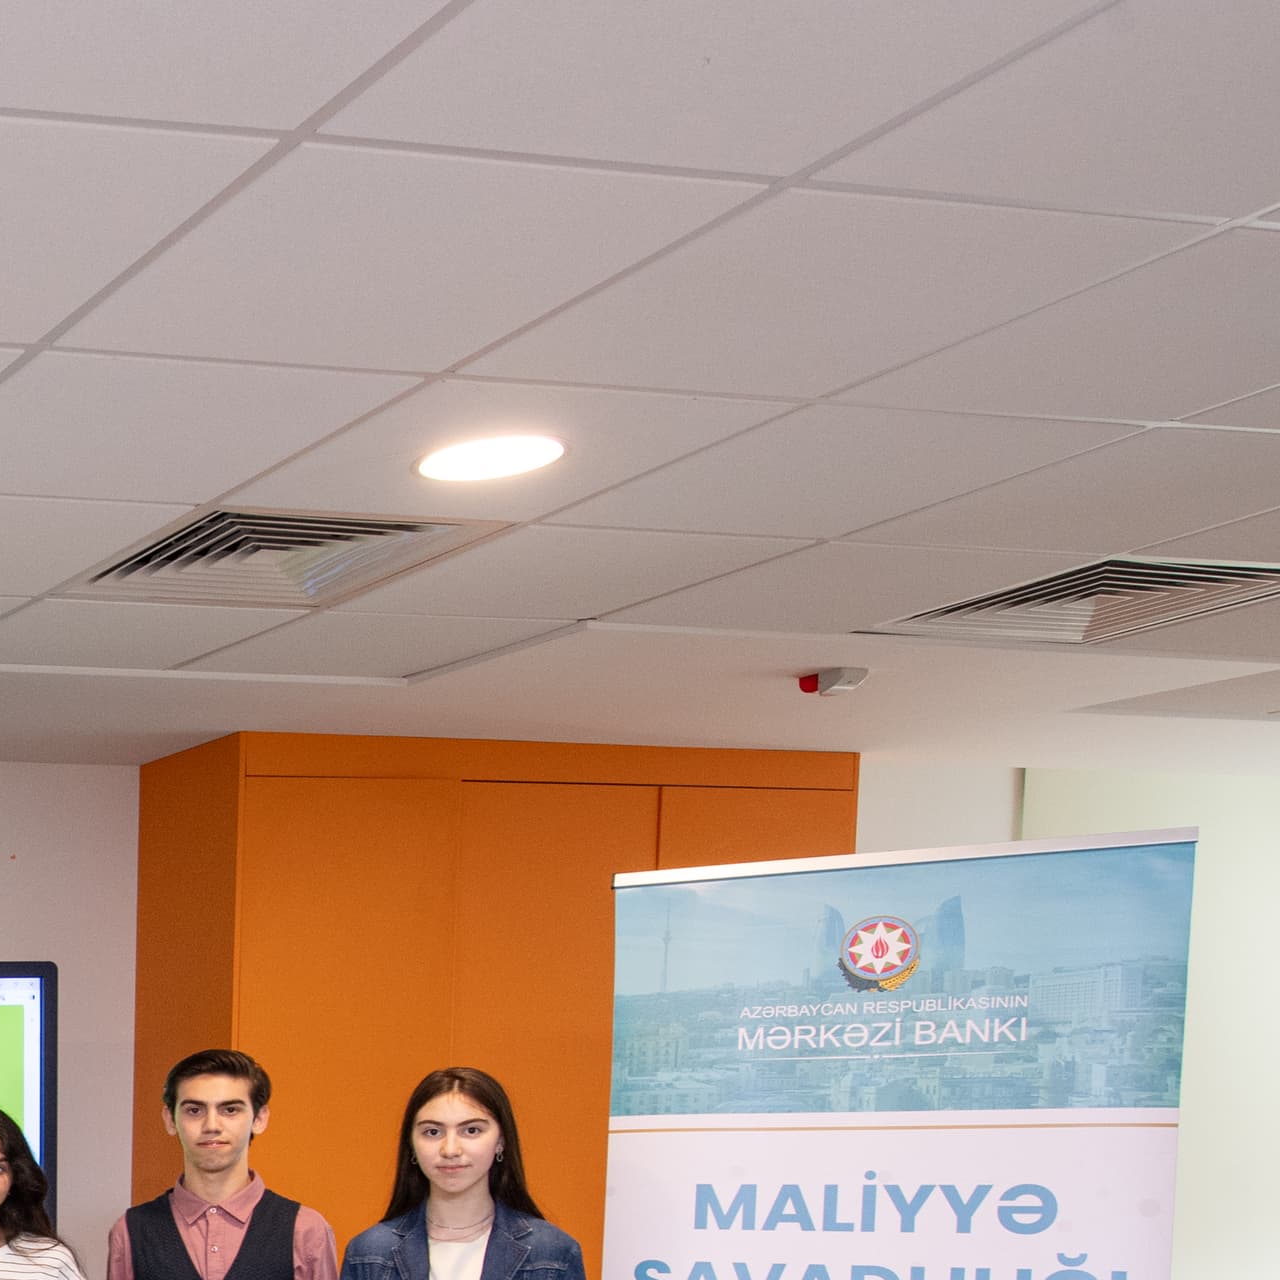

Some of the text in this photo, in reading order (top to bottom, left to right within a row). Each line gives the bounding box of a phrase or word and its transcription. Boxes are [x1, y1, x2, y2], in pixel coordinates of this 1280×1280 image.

[739, 1001, 858, 1019] AZƏRBAYCAN
[737, 1016, 1029, 1051] MƏRKƏZİ BANKI
[693, 1170, 1059, 1235] MALİYYƏ
